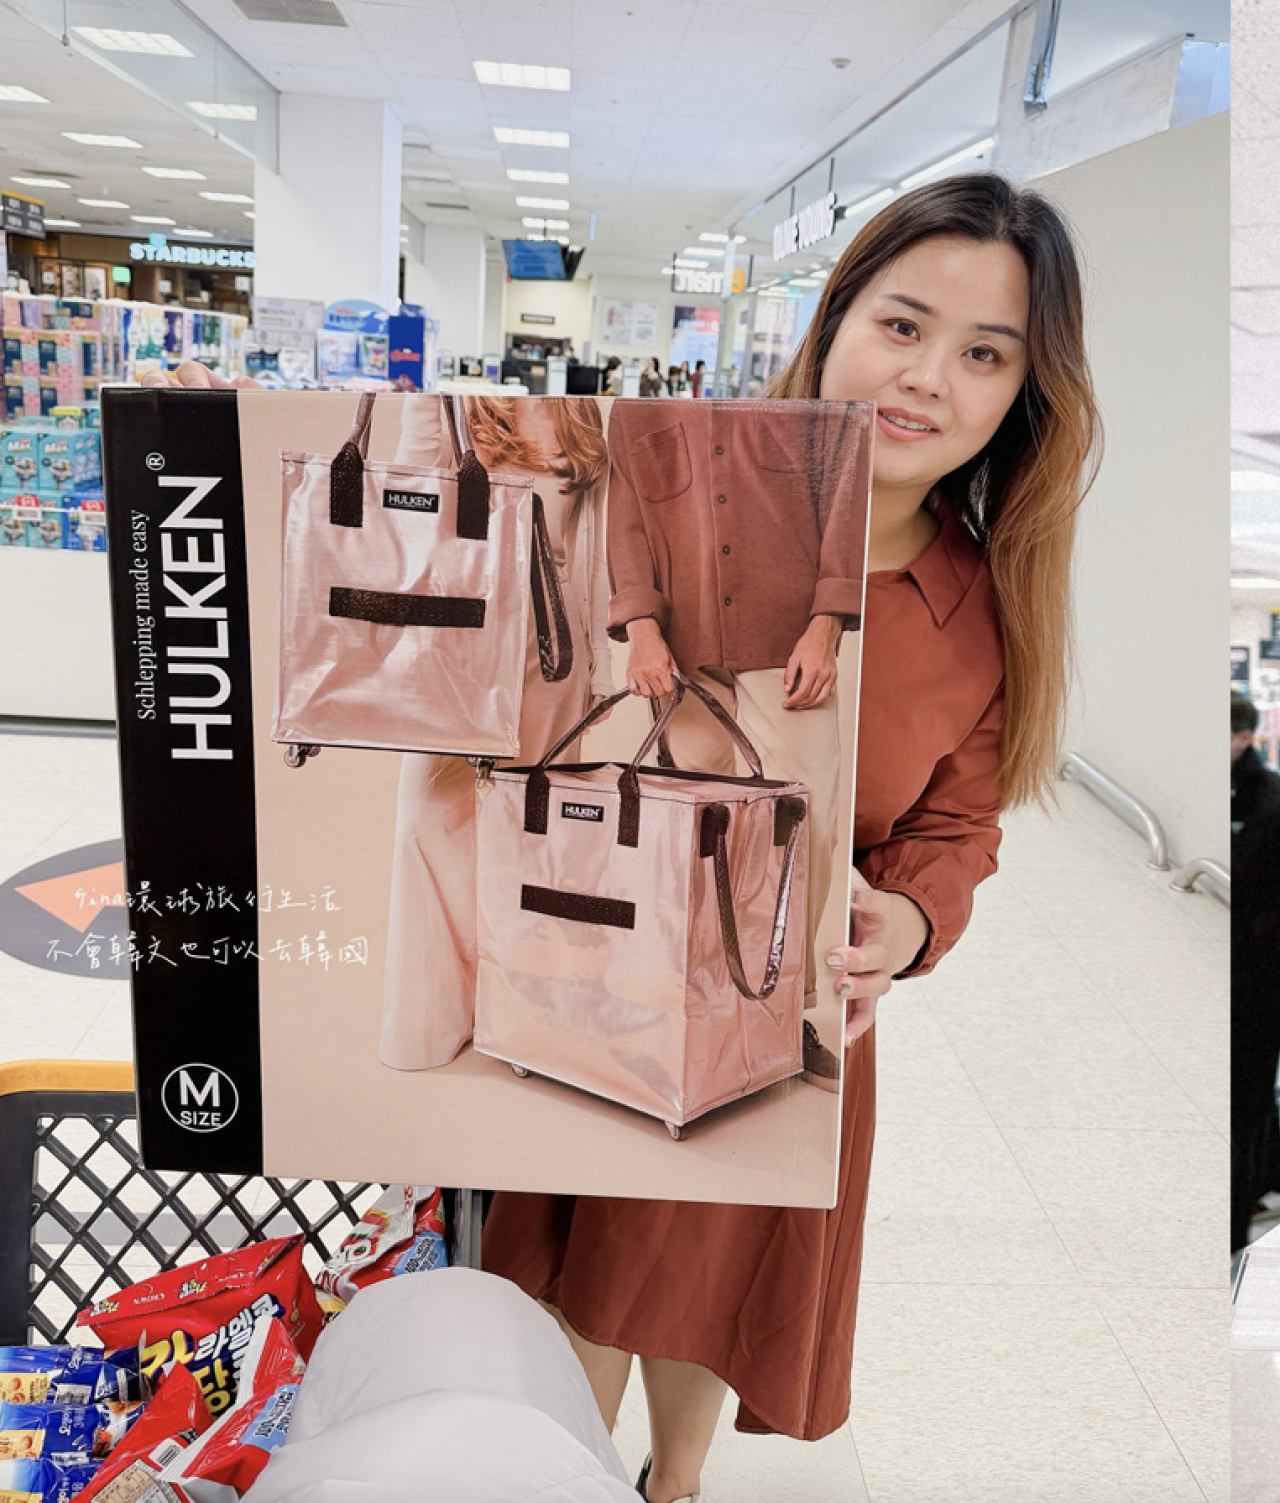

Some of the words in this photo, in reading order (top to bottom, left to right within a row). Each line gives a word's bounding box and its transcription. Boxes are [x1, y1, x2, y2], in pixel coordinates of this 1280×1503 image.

[129, 242, 256, 268] STARBUCKS
[130, 509, 150, 553] easy
[128, 553, 151, 612] made
[131, 616, 157, 720] Schlepping
[179, 1070, 220, 1107] M
[180, 1110, 222, 1127] SIZE
